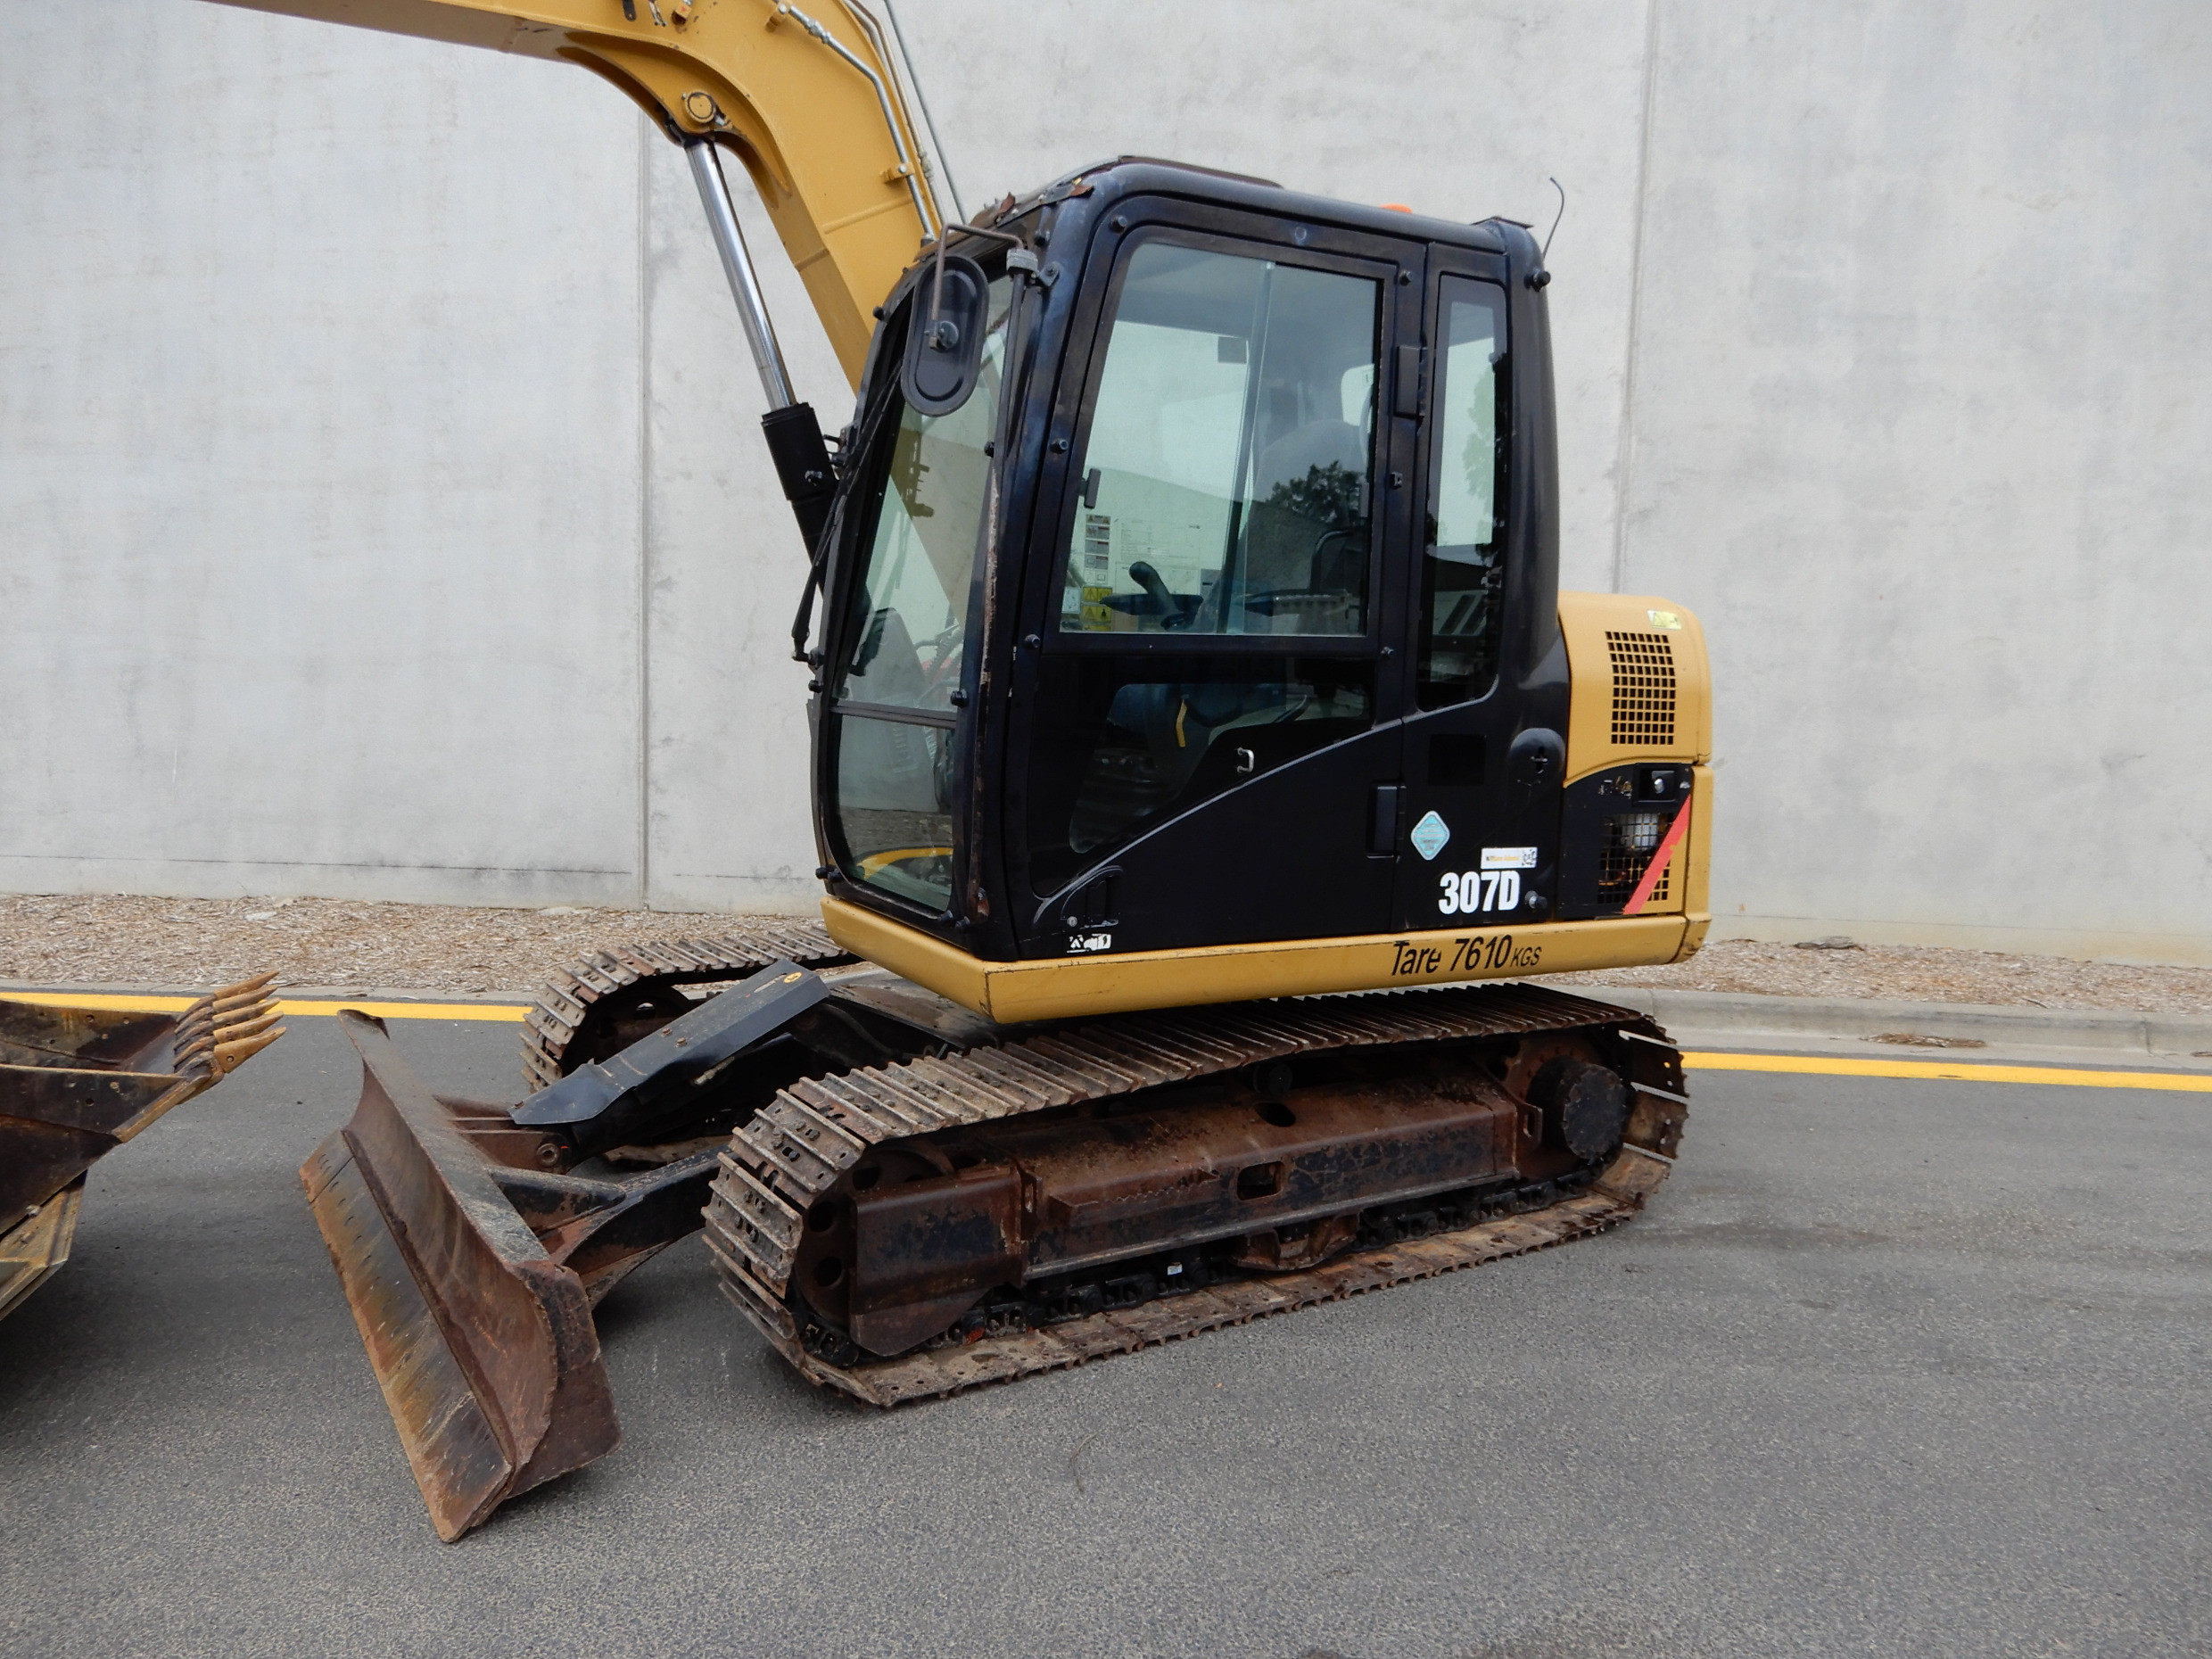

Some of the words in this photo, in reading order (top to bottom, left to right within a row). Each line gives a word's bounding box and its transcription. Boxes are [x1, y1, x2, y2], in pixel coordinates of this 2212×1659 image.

[1438, 870, 1521, 915] 307D
[1391, 940, 1442, 976] Tare
[1449, 934, 1513, 972] 7610
[1509, 946, 1543, 968] KGS
